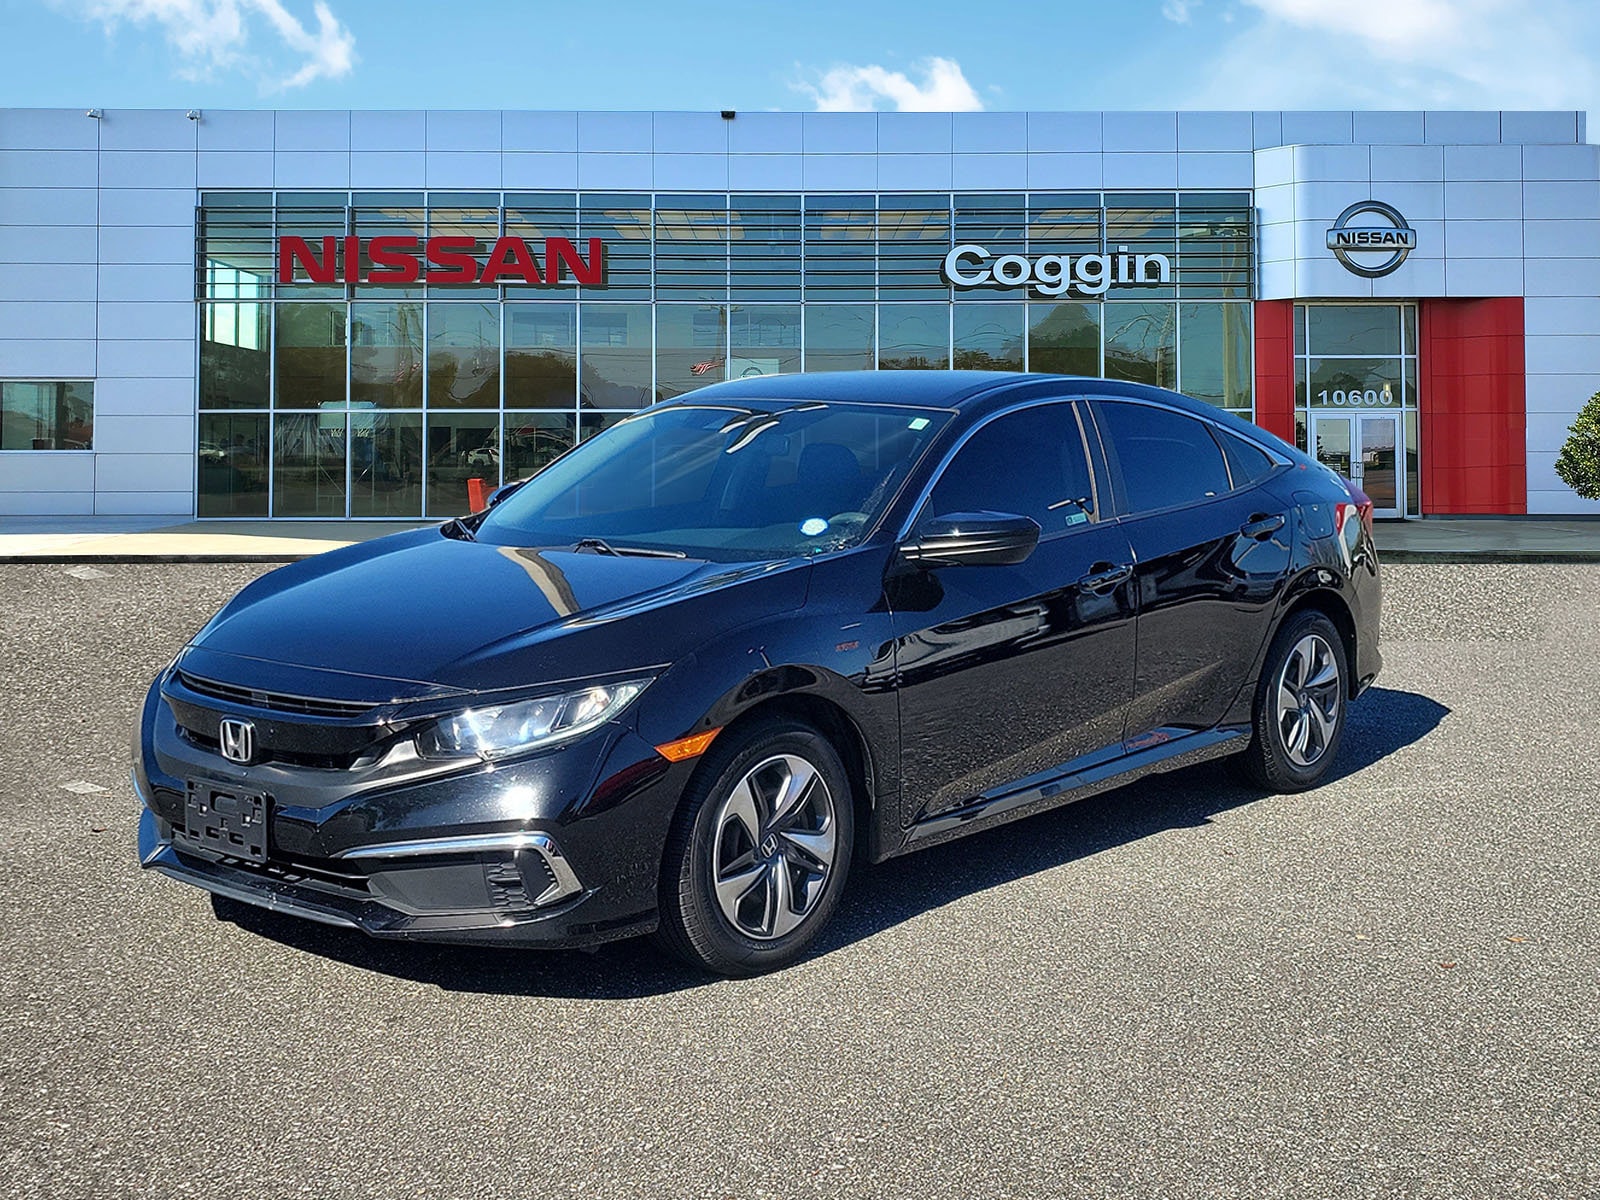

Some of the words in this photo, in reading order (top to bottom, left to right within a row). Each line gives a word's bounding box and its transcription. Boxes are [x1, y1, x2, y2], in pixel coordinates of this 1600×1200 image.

[1336, 232, 1409, 245] NISSAN
[279, 235, 603, 285] NISSAN
[944, 244, 1171, 295] Coggin
[1317, 389, 1394, 406] 10600
